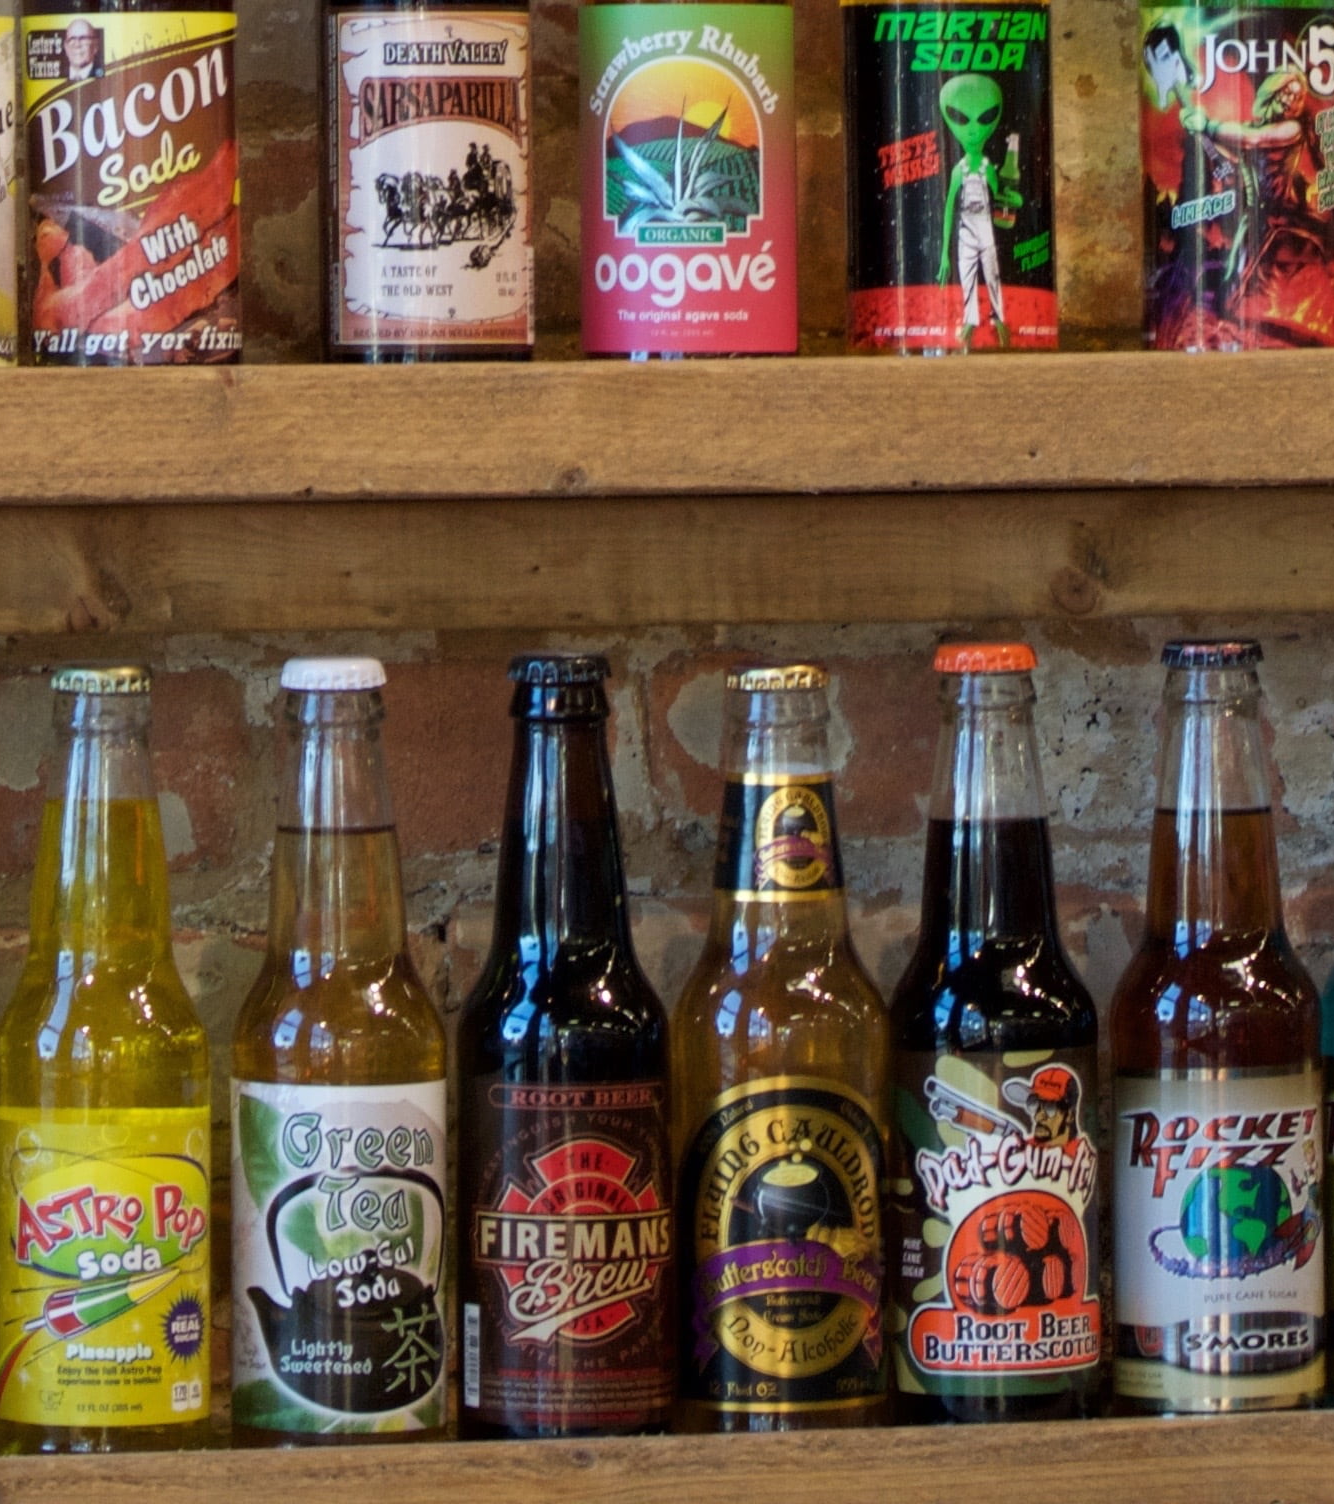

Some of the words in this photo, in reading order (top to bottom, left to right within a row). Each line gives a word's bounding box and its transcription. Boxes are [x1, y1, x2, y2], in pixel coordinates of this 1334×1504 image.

[384, 44, 445, 65] DEATH
[446, 40, 508, 65] VALLEY
[590, 30, 693, 116] Strawberry
[698, 26, 779, 116] Rhubarb
[1198, 35, 1306, 94] JOHN
[594, 236, 775, 307] oogavé
[618, 309, 640, 322] The
[644, 307, 686, 323] original
[686, 310, 719, 323] agave
[725, 310, 748, 322] soda
[284, 1113, 434, 1167] Green
[318, 1180, 411, 1231] Tea
[280, 1356, 373, 1374] Sweetened
[291, 1338, 353, 1361] Lightly
[382, 1307, 440, 1390] 茶
